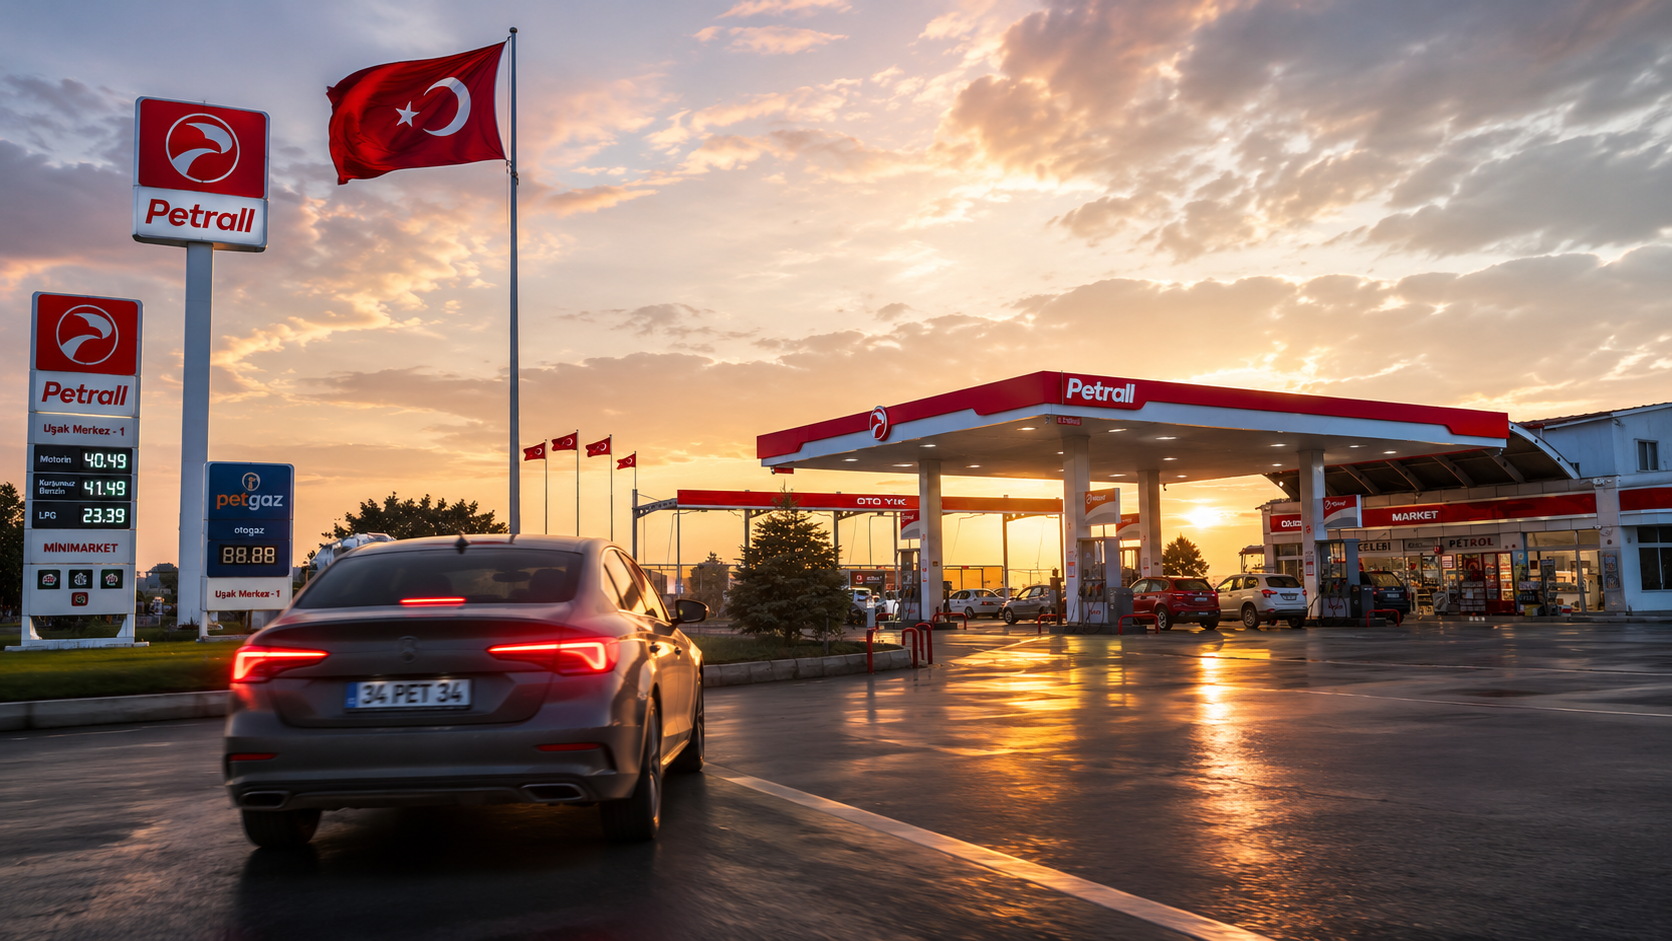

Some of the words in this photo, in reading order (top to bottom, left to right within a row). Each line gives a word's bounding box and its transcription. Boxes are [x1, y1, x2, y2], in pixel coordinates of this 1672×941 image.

[145, 198, 256, 233] Petrall
[41, 381, 129, 406] Petrall
[1066, 378, 1136, 403] Petrall
[43, 424, 70, 436] Uşak
[73, 424, 111, 436] Merkez
[119, 427, 125, 436] 1
[84, 453, 127, 469] 40.49
[83, 481, 126, 496] 41.49
[216, 492, 284, 511] petgaz
[856, 497, 881, 505] OTO
[38, 511, 57, 520] LPG
[82, 508, 125, 523] 23.39
[1392, 510, 1438, 521] MARKET
[234, 526, 265, 537] otogaz
[222, 547, 275, 564] 88.88
[275, 589, 281, 598] 1
[362, 684, 388, 705] 34
[391, 683, 433, 704] PET
[437, 682, 463, 703] 34
